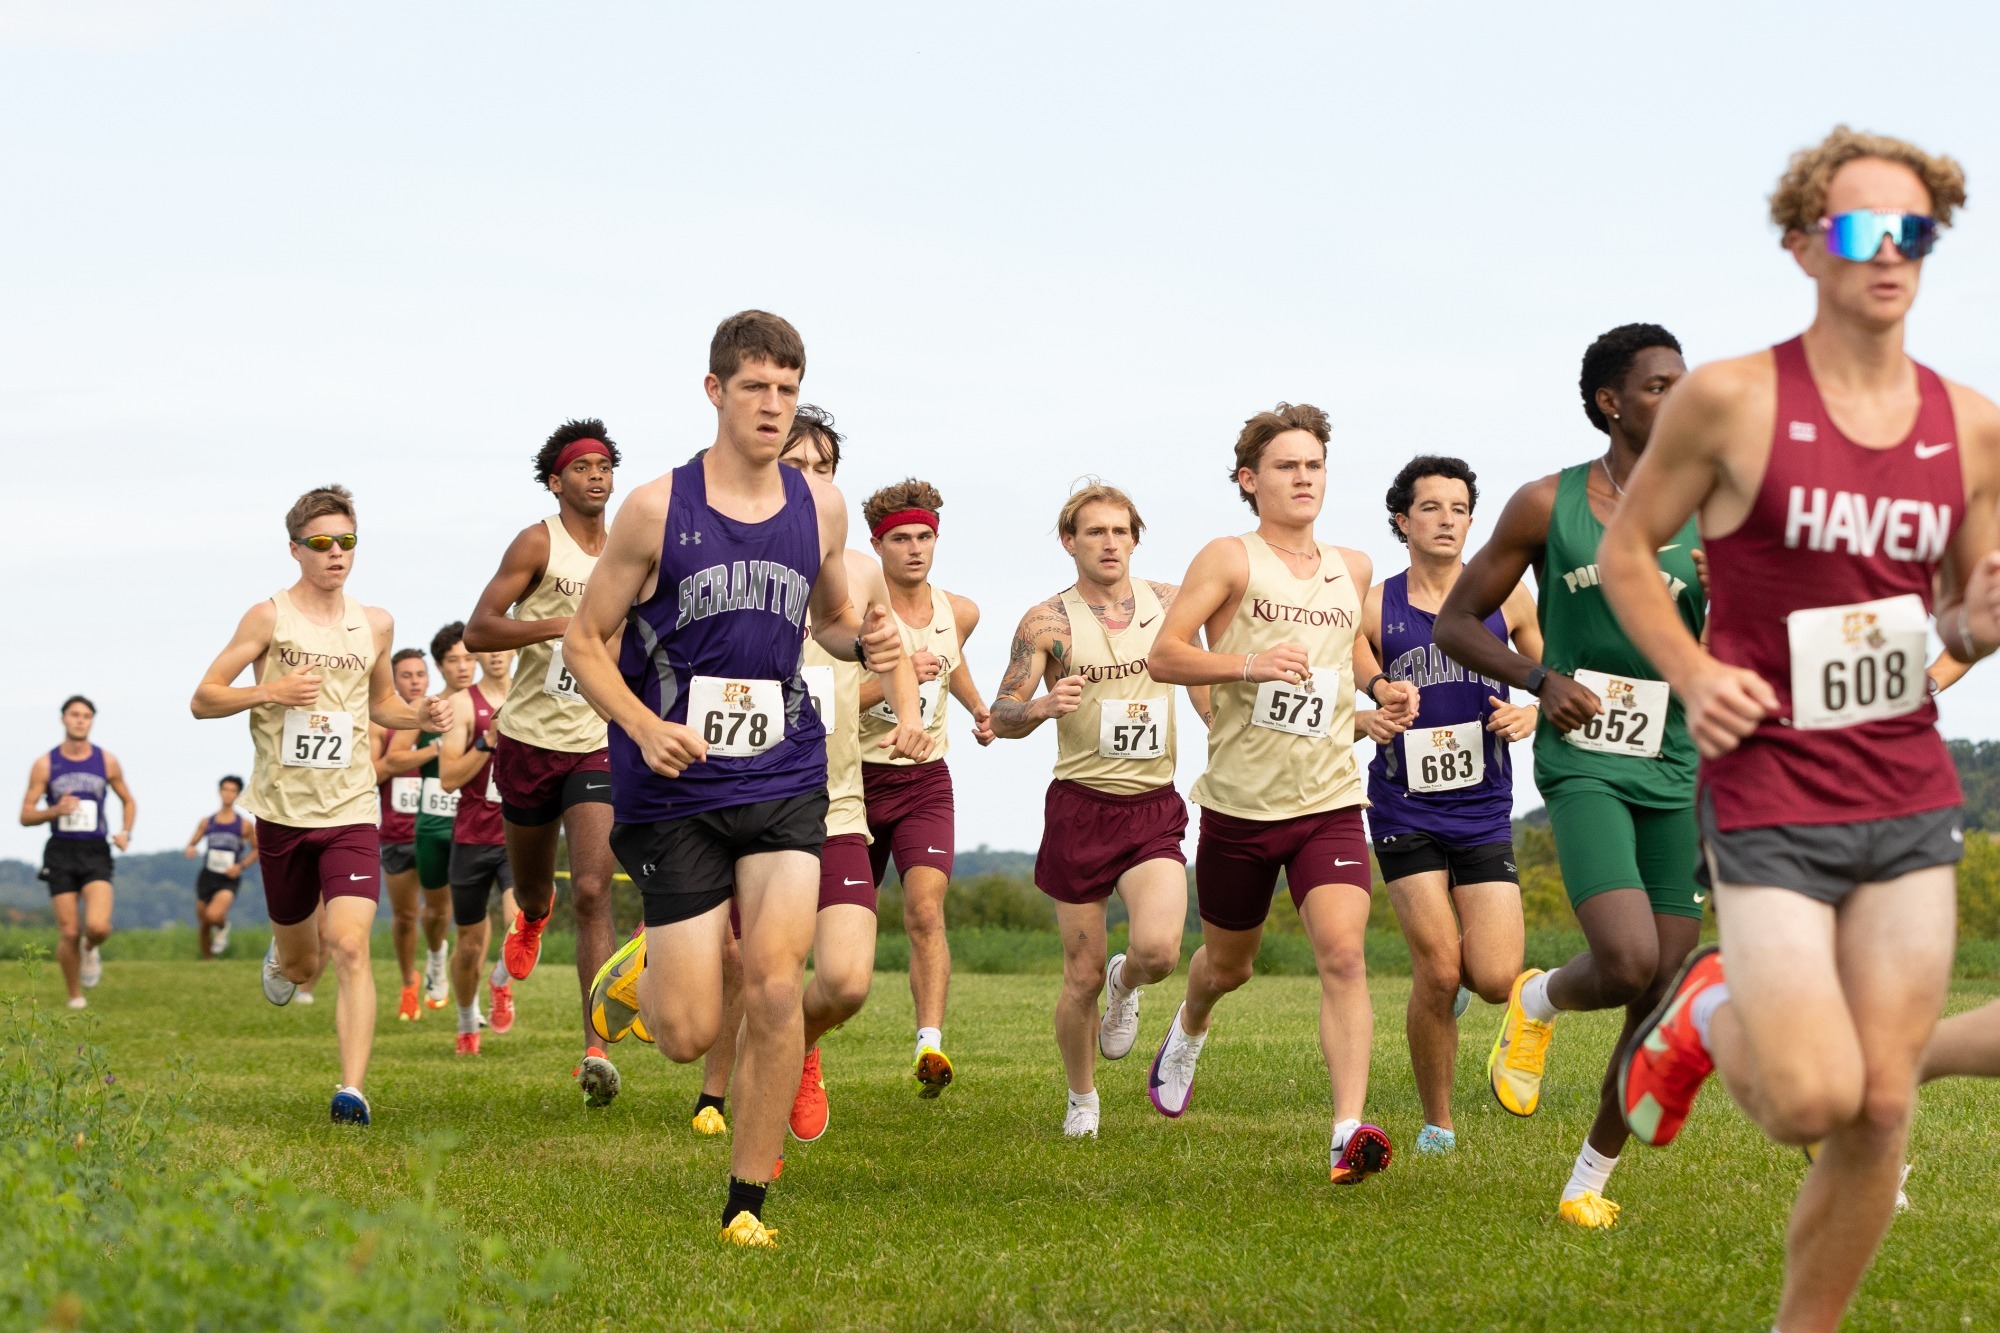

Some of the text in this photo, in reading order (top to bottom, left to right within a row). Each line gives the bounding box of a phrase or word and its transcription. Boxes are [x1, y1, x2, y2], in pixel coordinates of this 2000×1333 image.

[1784, 485, 1951, 563] HAVEN
[1251, 599, 1355, 629] KUTZTOWN
[278, 647, 368, 671] KUTZTOWN
[1824, 650, 1905, 711] 608
[1269, 690, 1323, 727] 573
[704, 711, 768, 747] 678
[1113, 724, 1158, 751] 571
[1584, 708, 1649, 746] 652
[295, 734, 342, 761] 572
[1421, 750, 1474, 784] 683
[400, 793, 419, 807] 60
[430, 794, 459, 812] 655
